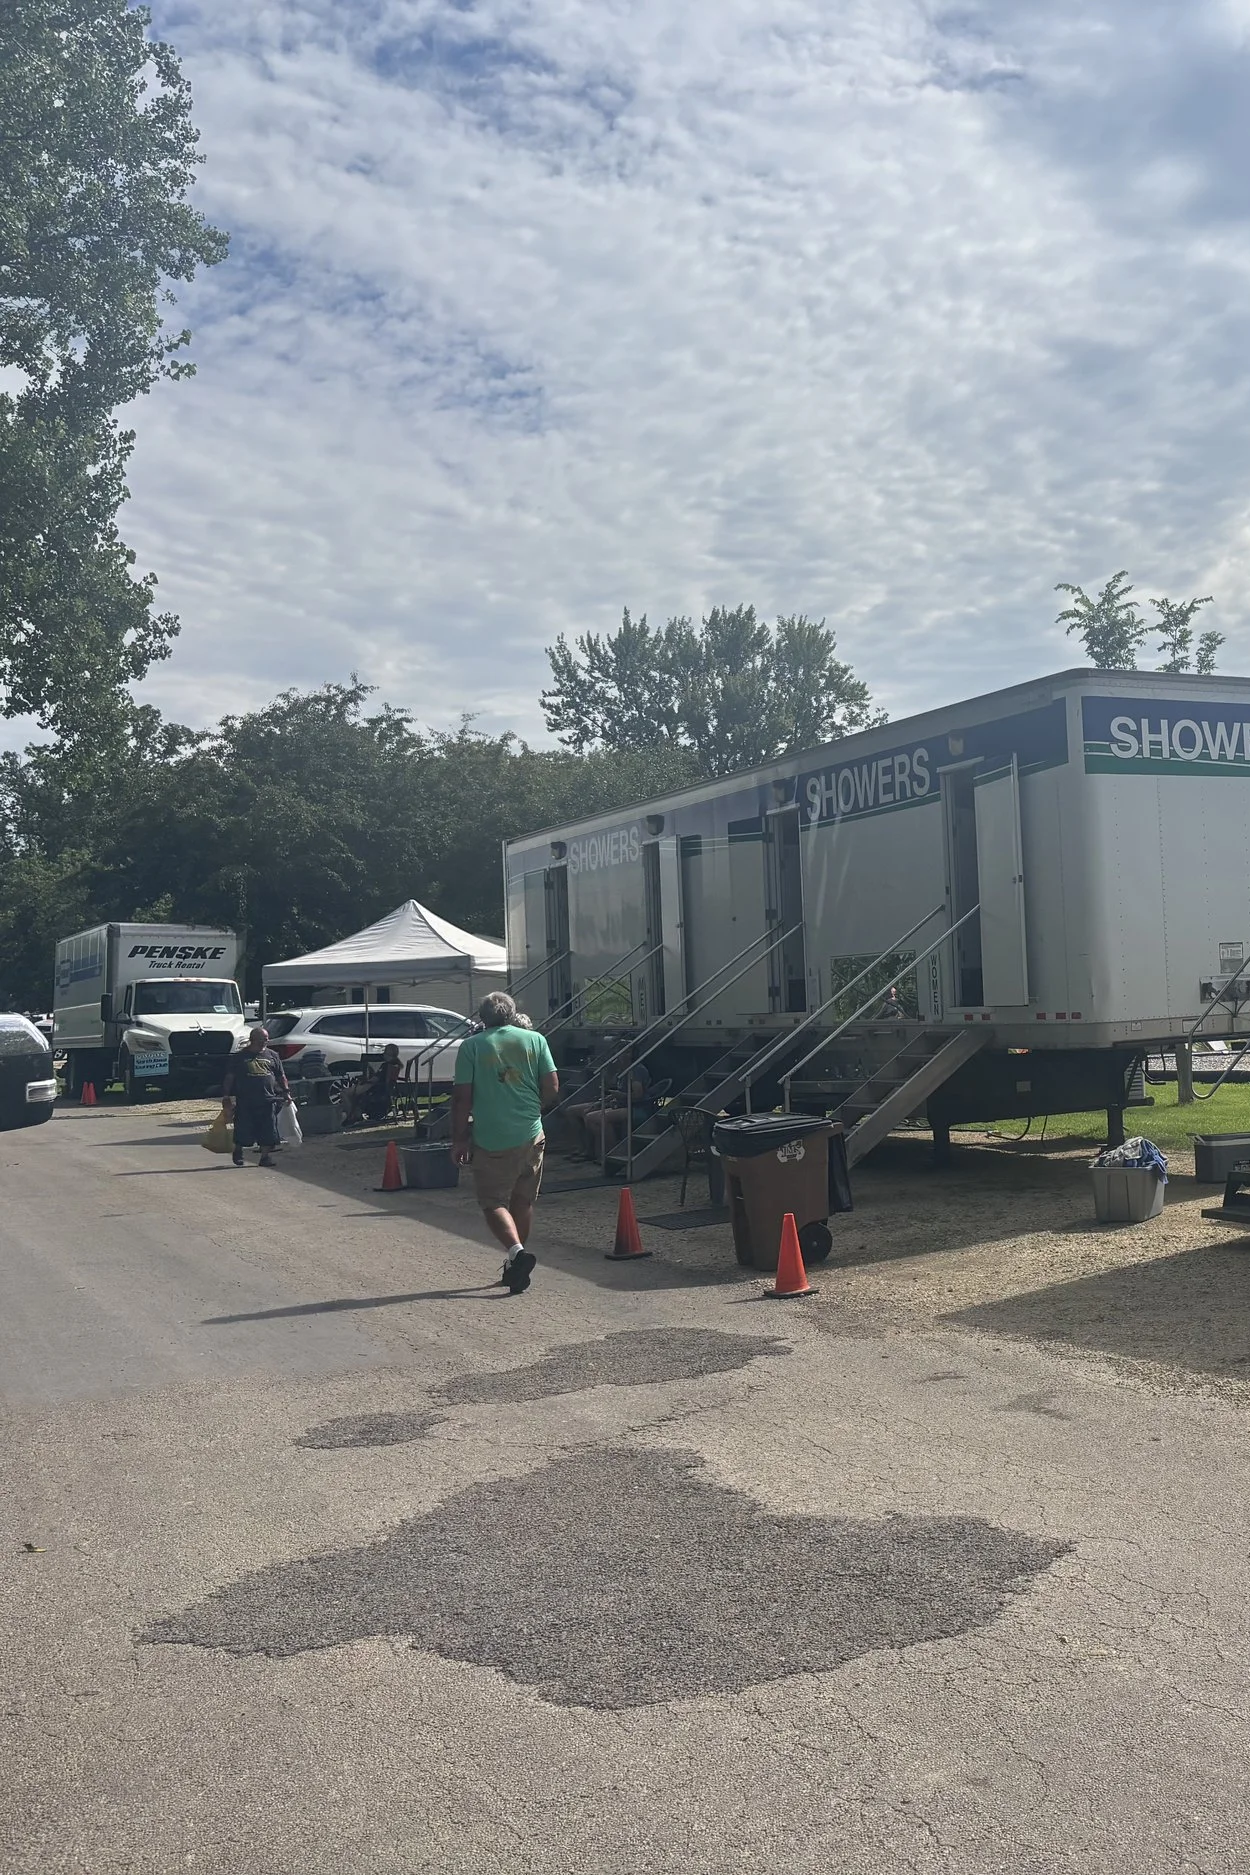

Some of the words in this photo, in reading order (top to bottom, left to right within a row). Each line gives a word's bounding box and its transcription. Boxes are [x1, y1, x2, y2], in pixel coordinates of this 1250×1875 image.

[805, 747, 930, 821] SHOWERS
[569, 826, 640, 875] SHOWERS
[128, 945, 226, 961] PENSKE
[148, 960, 172, 969] Truck
[174, 961, 205, 969] Rental
[930, 954, 939, 1016] WOMEN
